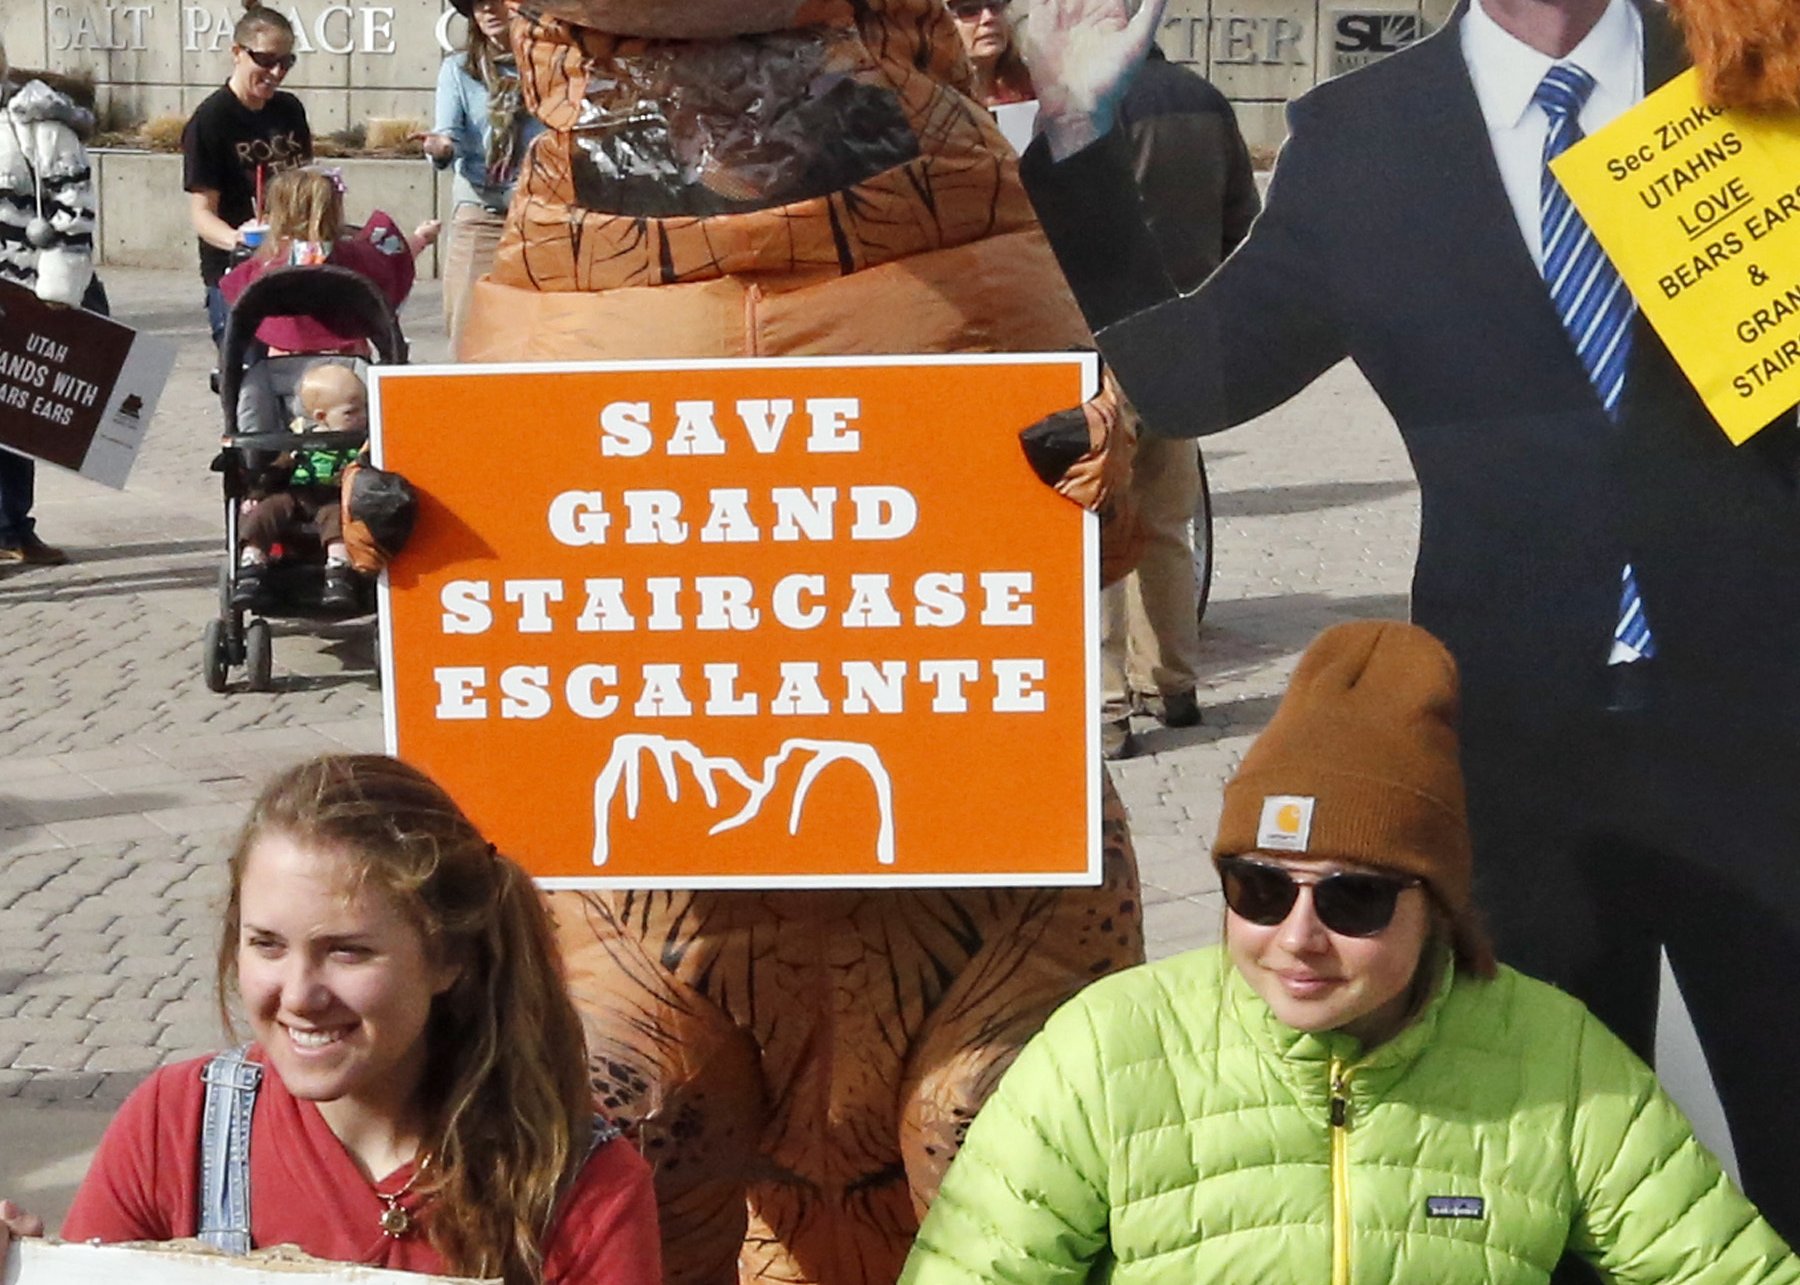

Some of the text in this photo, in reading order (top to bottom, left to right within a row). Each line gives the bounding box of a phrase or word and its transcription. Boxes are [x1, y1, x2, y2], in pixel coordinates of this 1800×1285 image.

[50, 4, 154, 52] SALT
[184, 5, 396, 55] PAACE
[236, 131, 301, 162] ROCK
[1606, 145, 1654, 182] Sec
[1638, 131, 1744, 210] UTAHNS
[1676, 176, 1752, 236] LOVE
[1657, 232, 1744, 301] BEARS
[1747, 263, 1769, 287] &
[26, 332, 69, 364] UTAH
[32, 397, 74, 426] EARS
[52, 371, 99, 408] WITH
[599, 396, 862, 458] SAVE
[546, 484, 920, 547] GRAND
[439, 570, 1035, 635] STAIRCASE
[432, 657, 1047, 721] ESCALANTE
